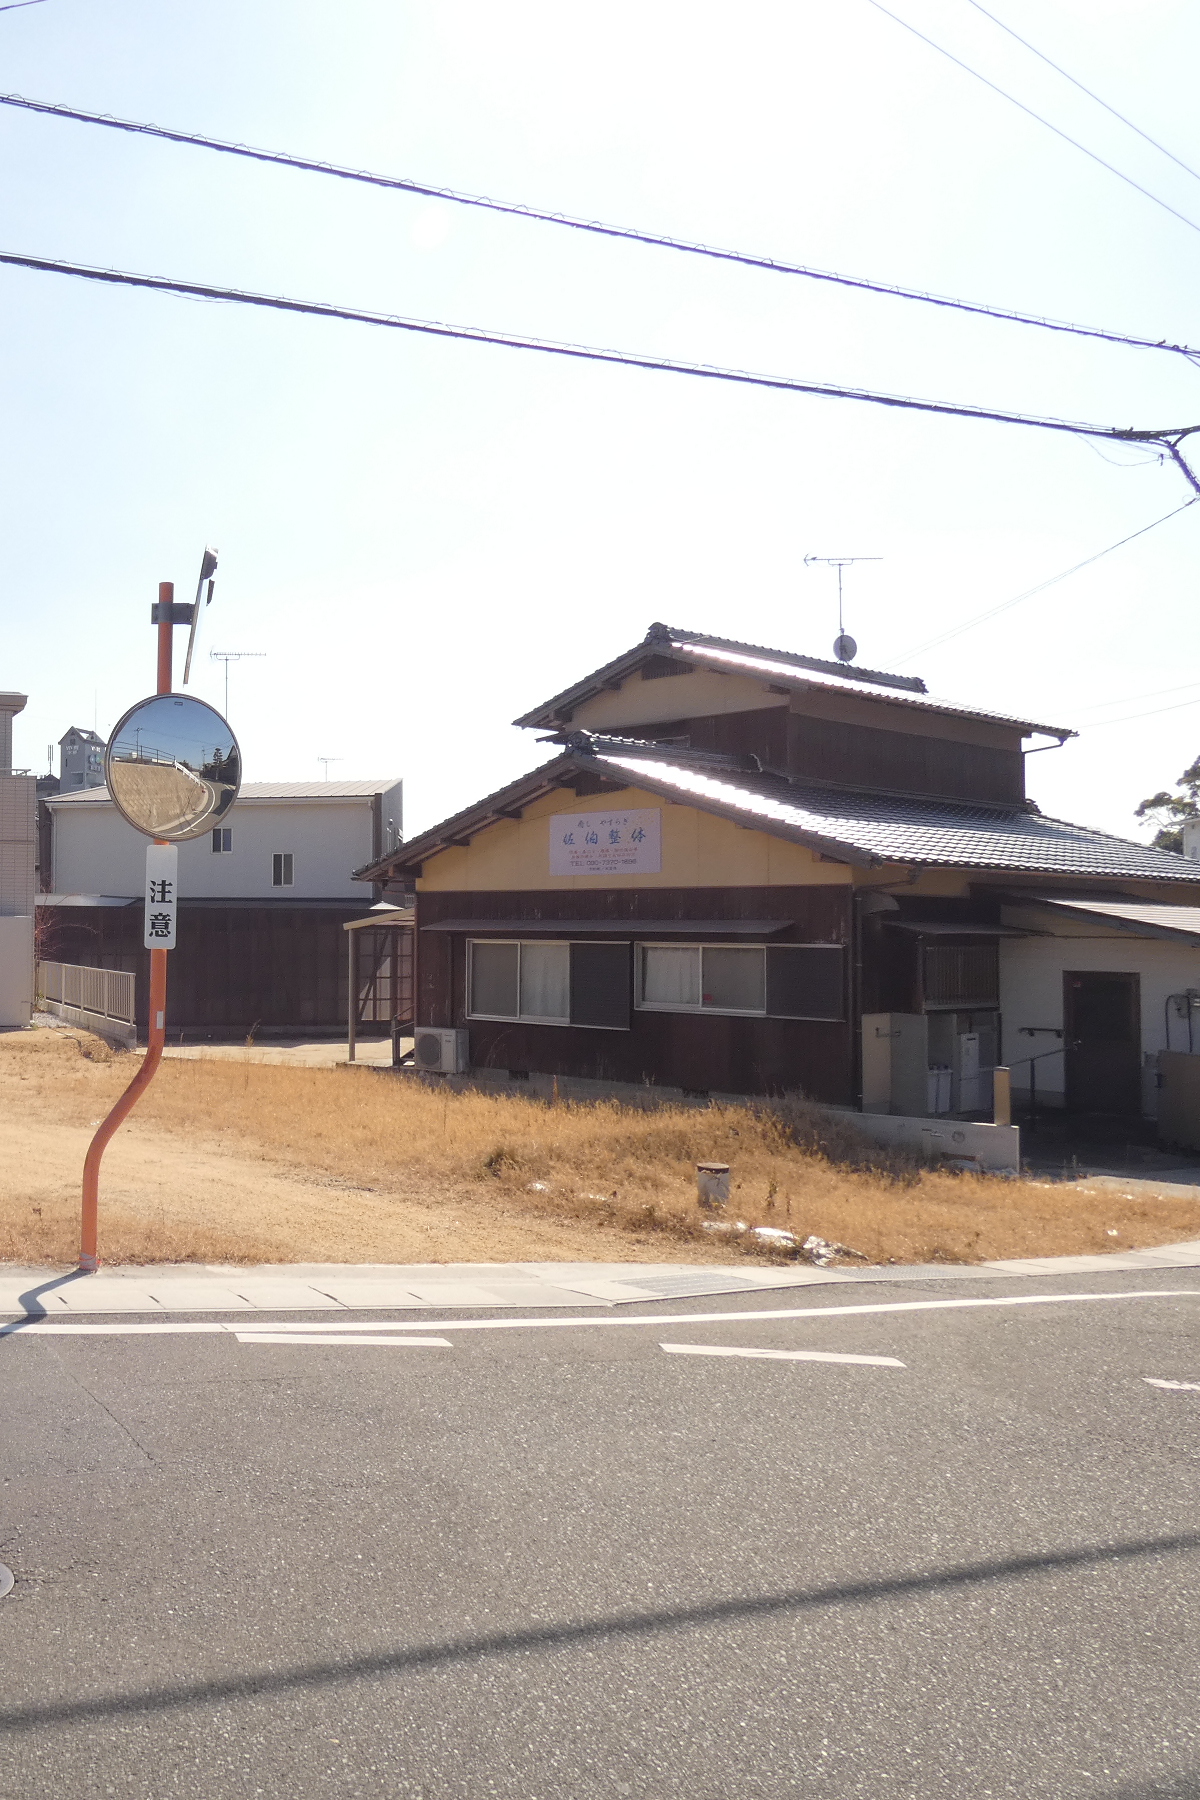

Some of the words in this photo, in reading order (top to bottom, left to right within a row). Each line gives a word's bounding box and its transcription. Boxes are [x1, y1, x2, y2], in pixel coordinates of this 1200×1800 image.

[563, 827, 647, 846] 佐伯整体
[148, 879, 174, 938] 注意
